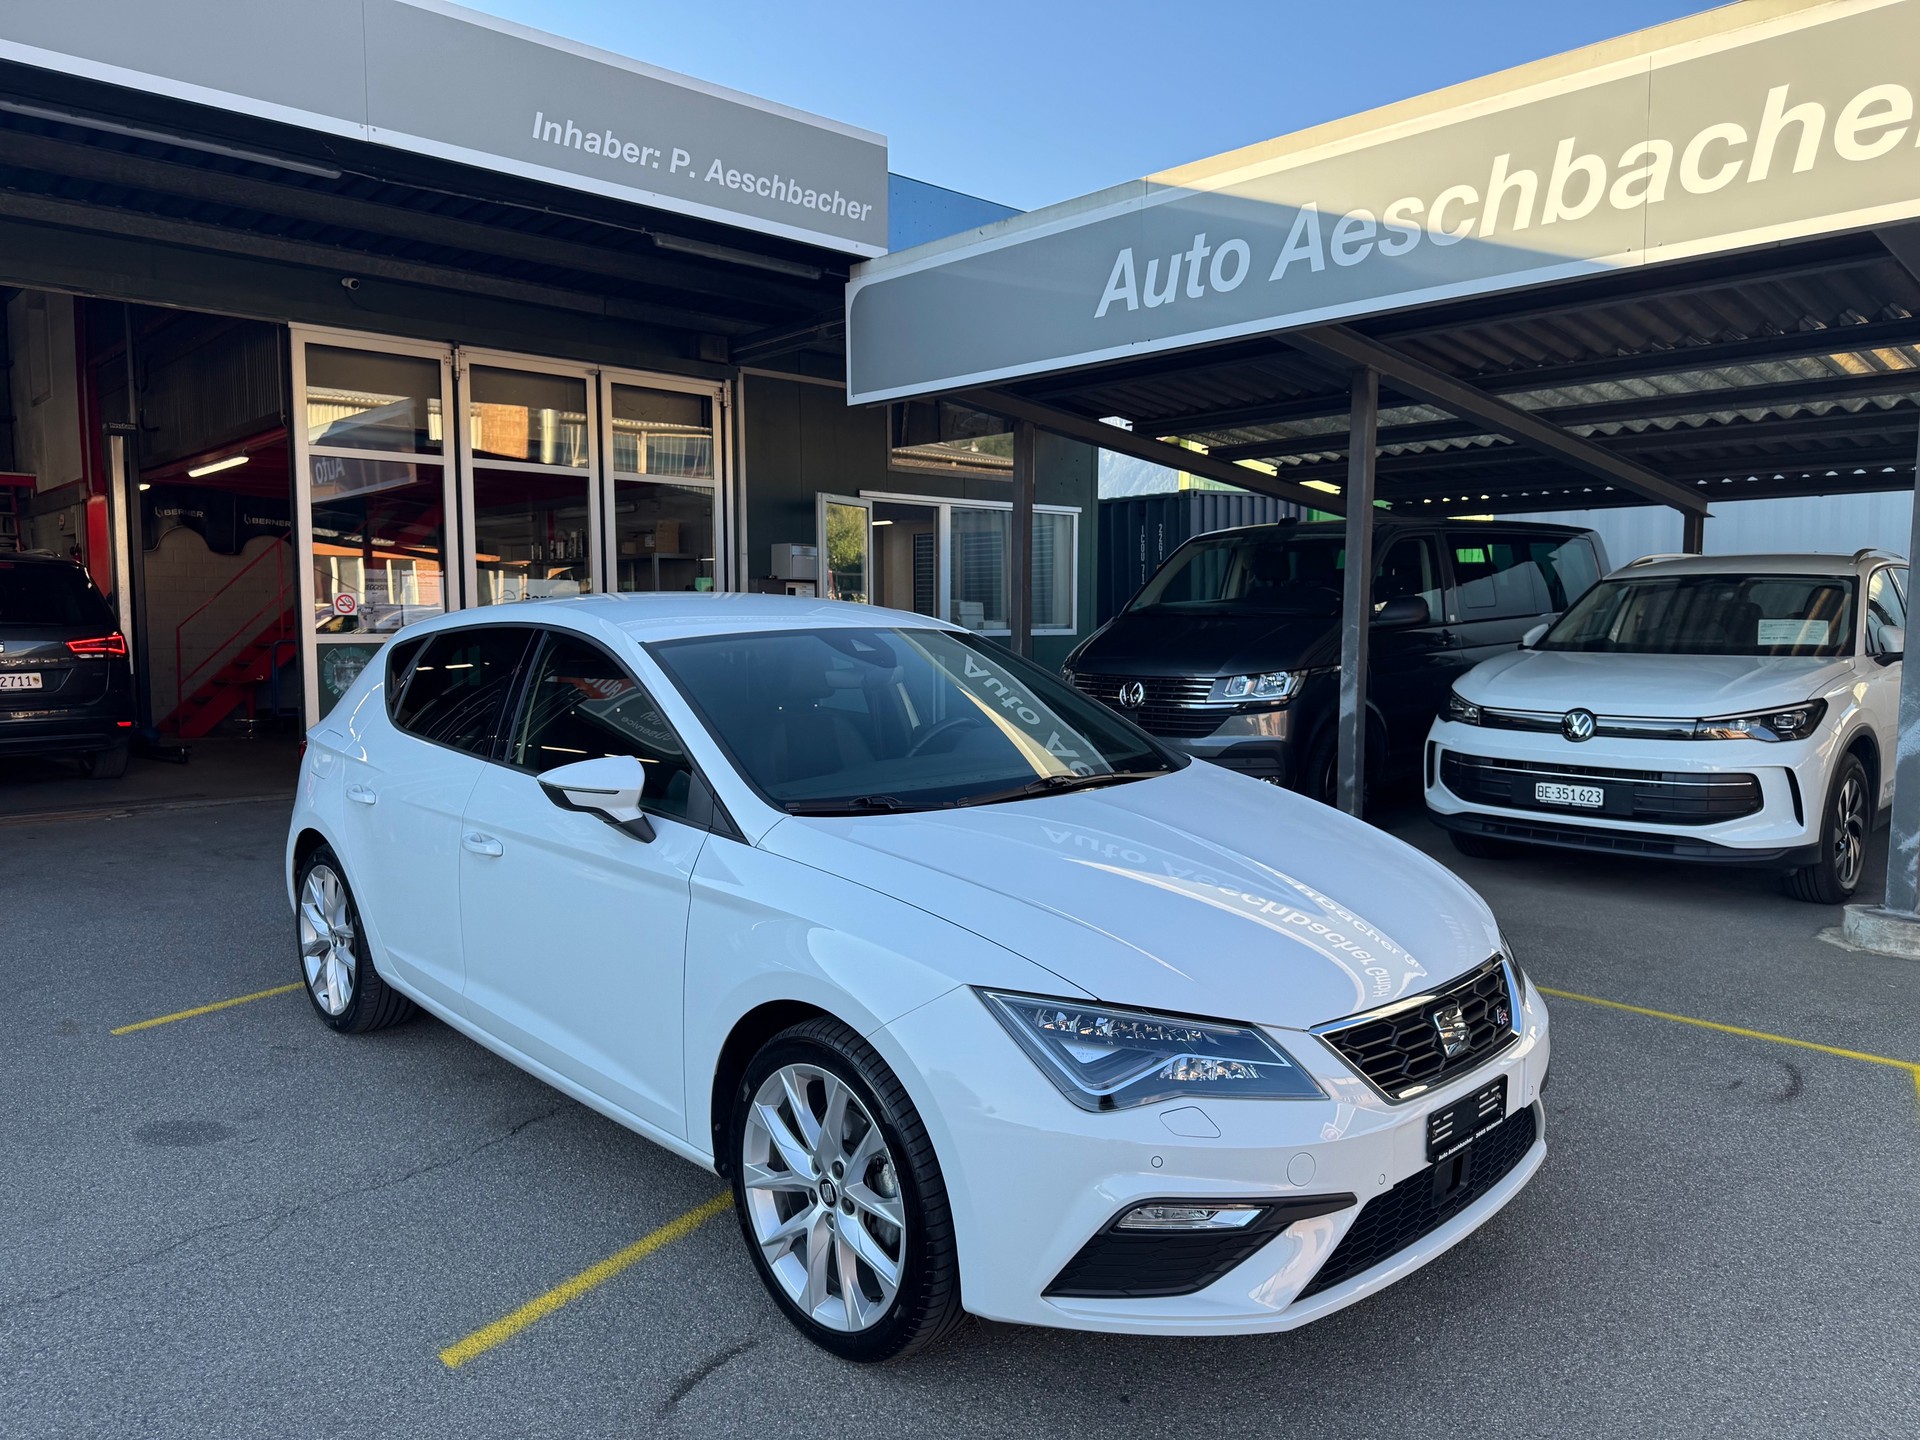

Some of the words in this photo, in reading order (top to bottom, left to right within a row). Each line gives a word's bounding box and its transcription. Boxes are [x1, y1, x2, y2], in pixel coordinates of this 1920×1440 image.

[532, 112, 661, 168] Inhaber:
[669, 147, 696, 178] P.
[704, 158, 873, 221] Aeschbacher
[1094, 233, 1250, 318] Auto
[1268, 83, 1920, 281] Aeschbache
[164, 508, 204, 517] BERNER
[252, 517, 291, 527] BERNER
